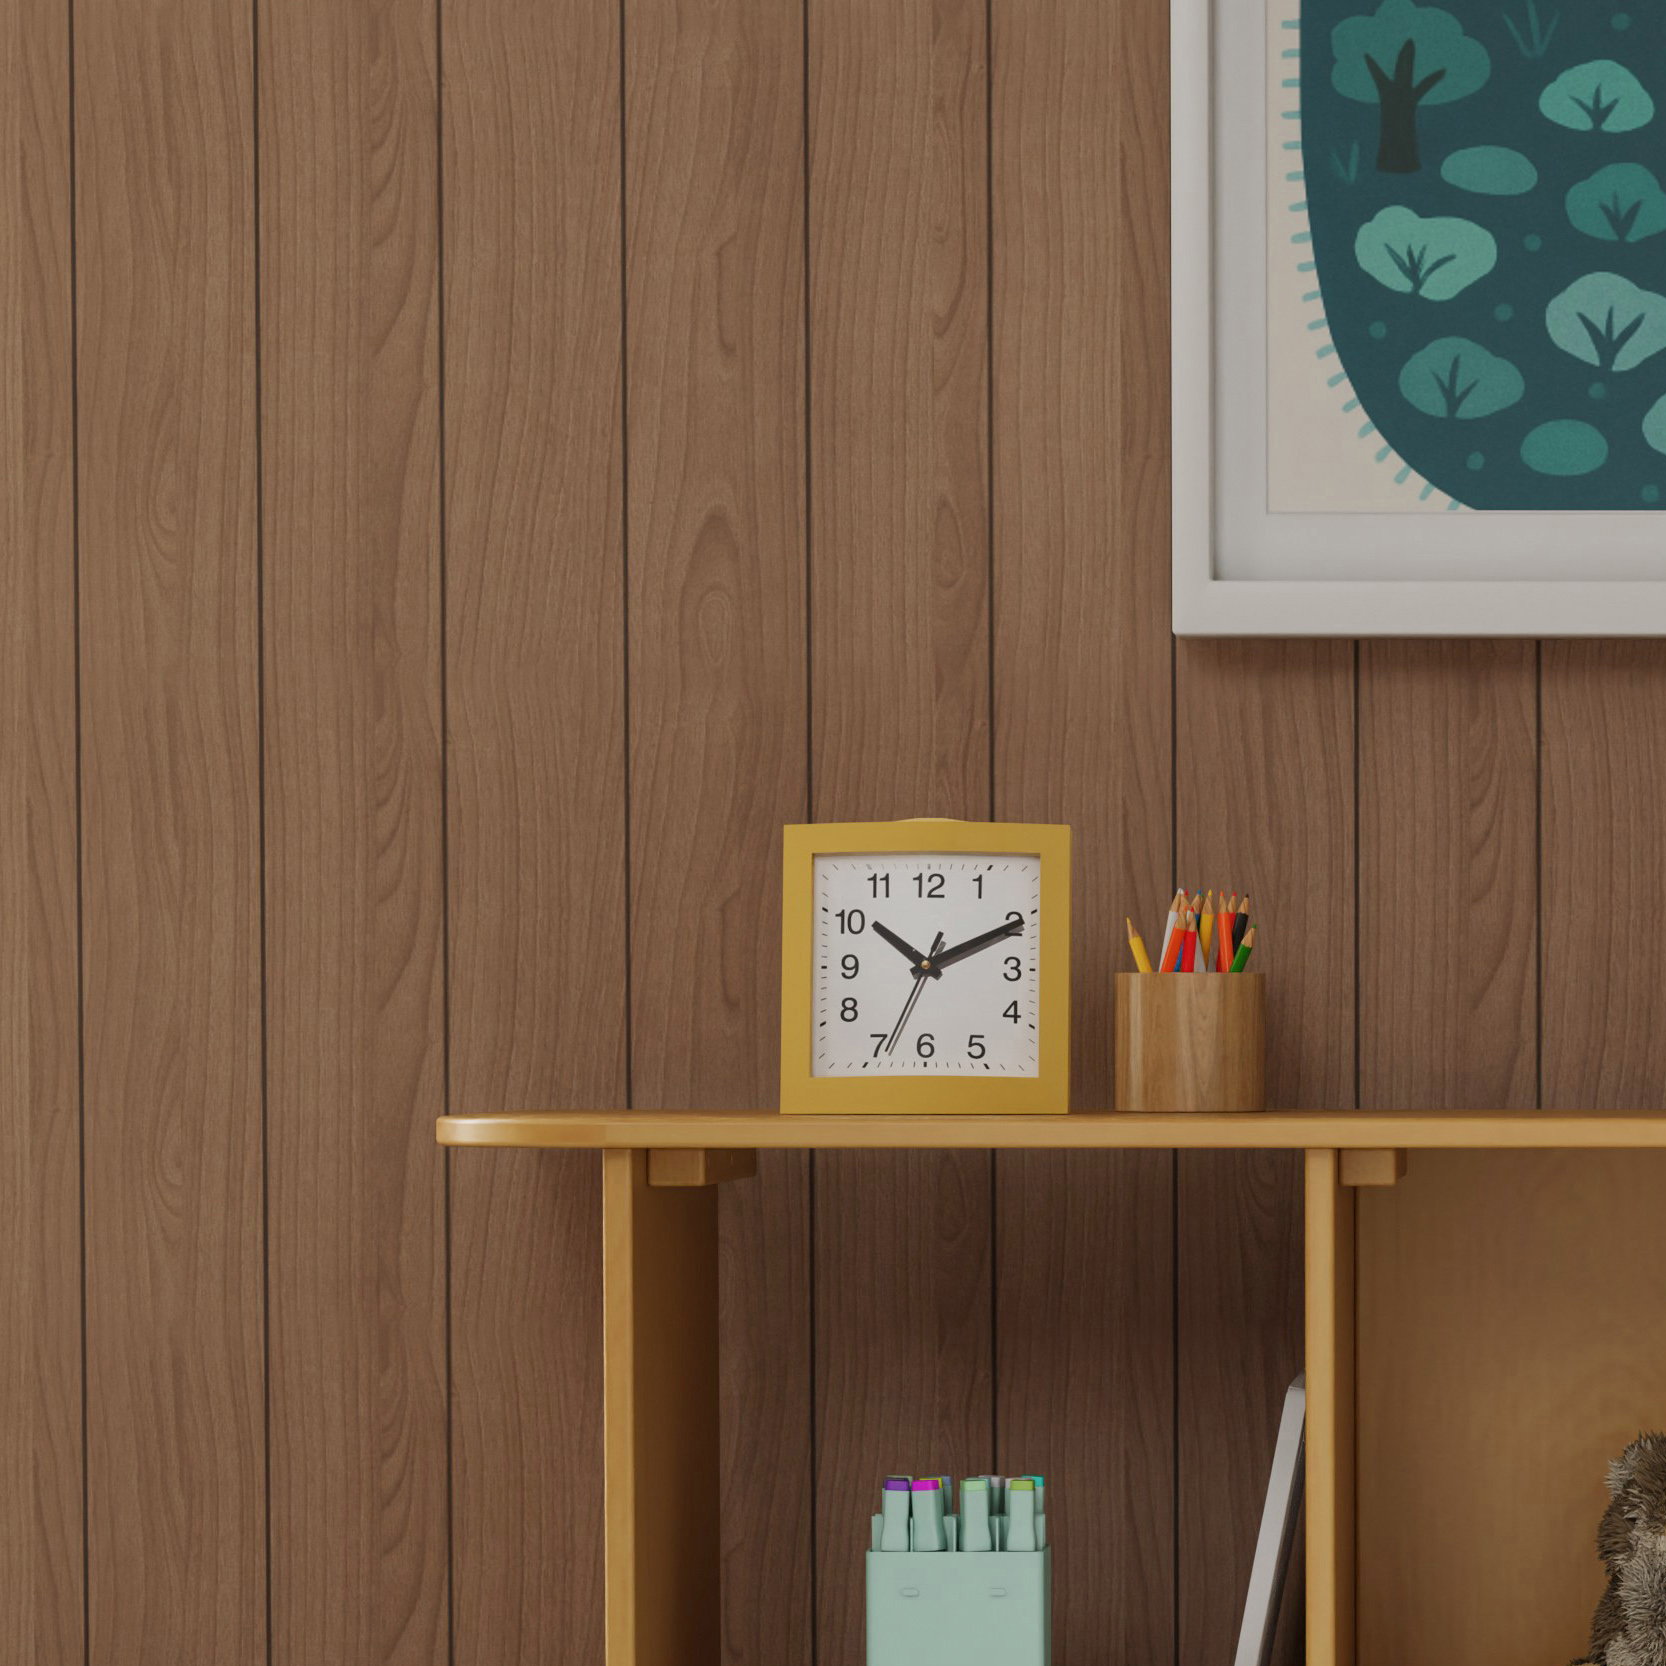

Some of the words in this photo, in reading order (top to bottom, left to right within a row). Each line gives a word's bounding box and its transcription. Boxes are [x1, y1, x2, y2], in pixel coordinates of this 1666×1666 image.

[866, 872, 890, 898] 11
[912, 873, 945, 899] 12
[972, 874, 983, 899] 1
[835, 909, 866, 935] 10
[840, 954, 860, 980] 9
[1003, 956, 1022, 982] 3
[840, 997, 859, 1022] 8
[1002, 1000, 1022, 1024] 4
[869, 1033, 888, 1058] 7
[916, 1033, 935, 1059] 6
[967, 1034, 986, 1059] 5
